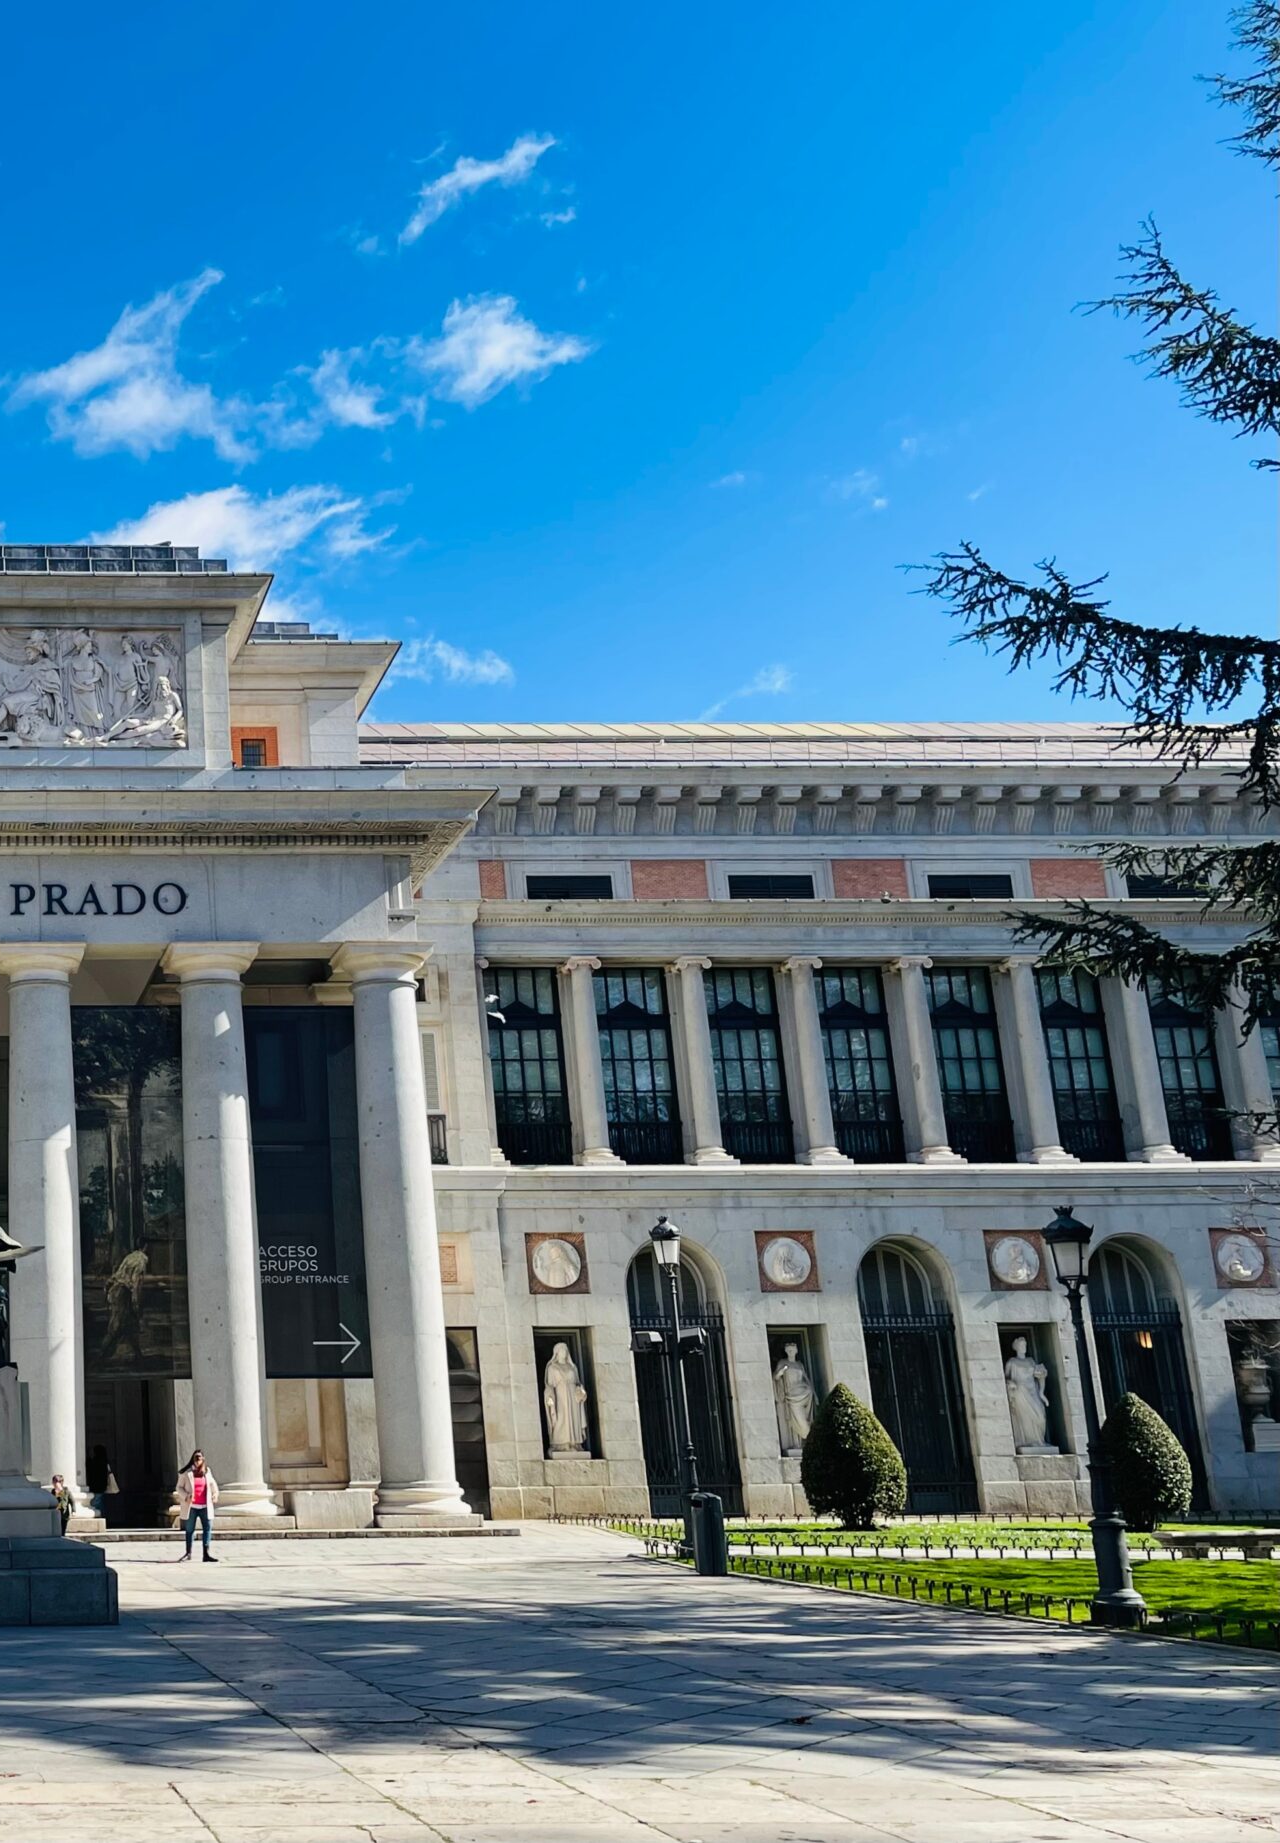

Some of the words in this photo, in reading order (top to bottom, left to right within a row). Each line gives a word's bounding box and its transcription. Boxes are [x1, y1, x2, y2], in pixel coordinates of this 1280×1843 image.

[10, 882, 188, 916] PRADO
[260, 1245, 318, 1257] ACCESO
[260, 1259, 319, 1272] GRUPOS
[295, 1275, 349, 1284] ENTRANCE
